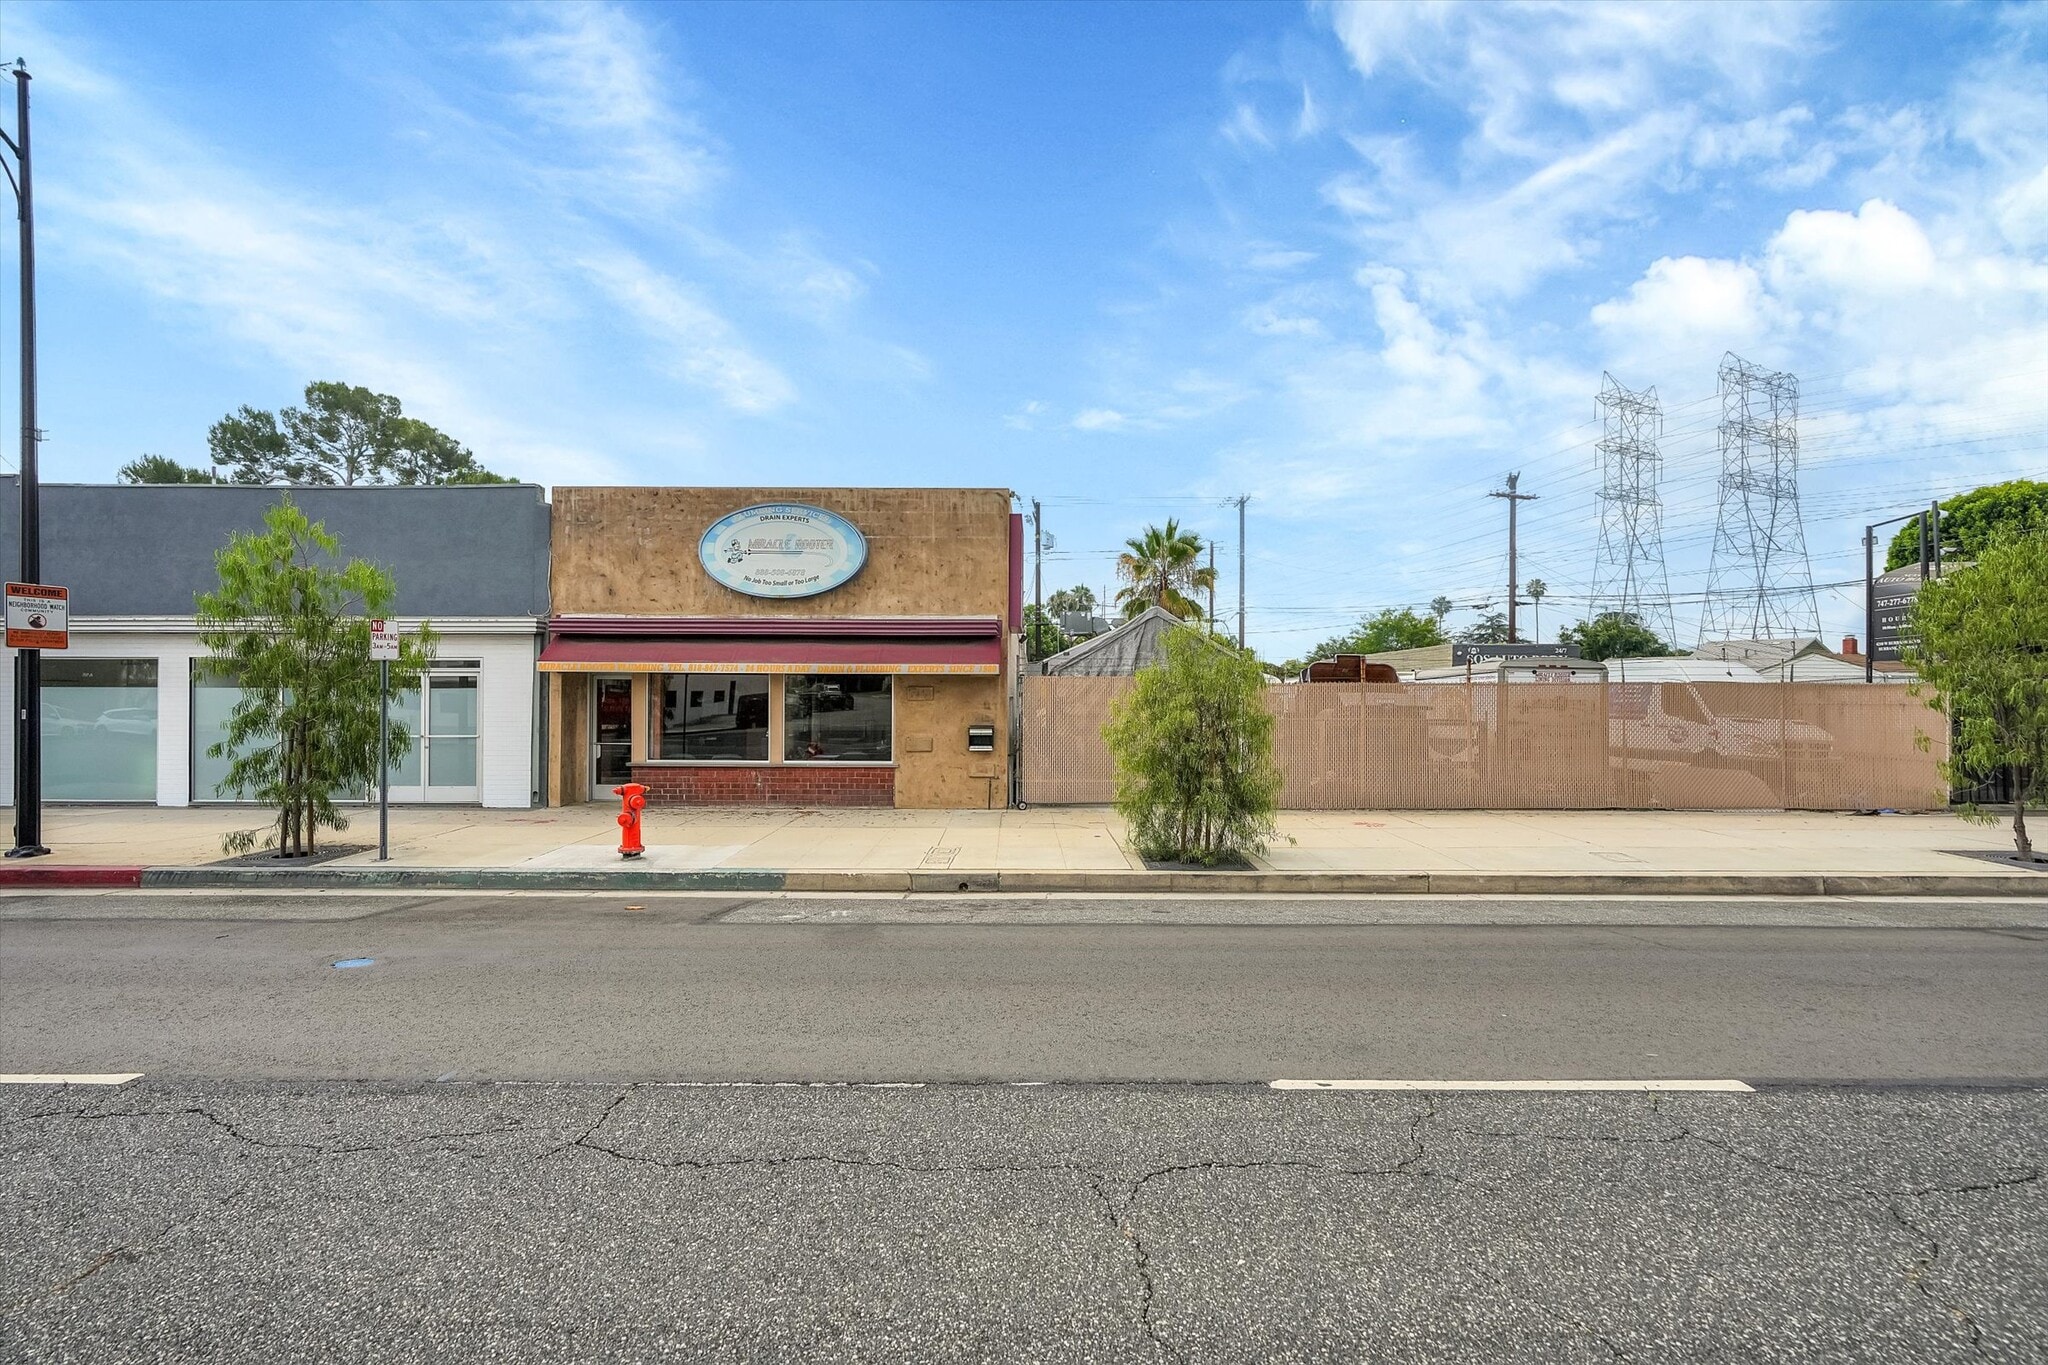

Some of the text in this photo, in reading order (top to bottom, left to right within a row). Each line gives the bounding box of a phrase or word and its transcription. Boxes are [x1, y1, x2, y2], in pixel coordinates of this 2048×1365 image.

[760, 514, 810, 523] DRAIN EXPERTS
[748, 538, 834, 550] MIRACLE ROOTER
[772, 579, 787, 587] Small
[805, 575, 820, 583] Large
[11, 586, 63, 597] WELCOME
[9, 601, 48, 610] NEIGHBORHOOD
[372, 621, 383, 631] NO
[372, 633, 398, 642] PARKING
[617, 663, 664, 671] PLUMBING
[745, 664, 756, 672] 24
[757, 664, 785, 672] HOURS
[787, 664, 793, 672] A
[794, 664, 811, 672] DAY
[817, 665, 845, 673] DRAIN
[846, 665, 853, 673] &
[855, 665, 901, 673] PLUMBING
[908, 665, 945, 673] EXPERTS
[948, 665, 975, 673] SINCE
